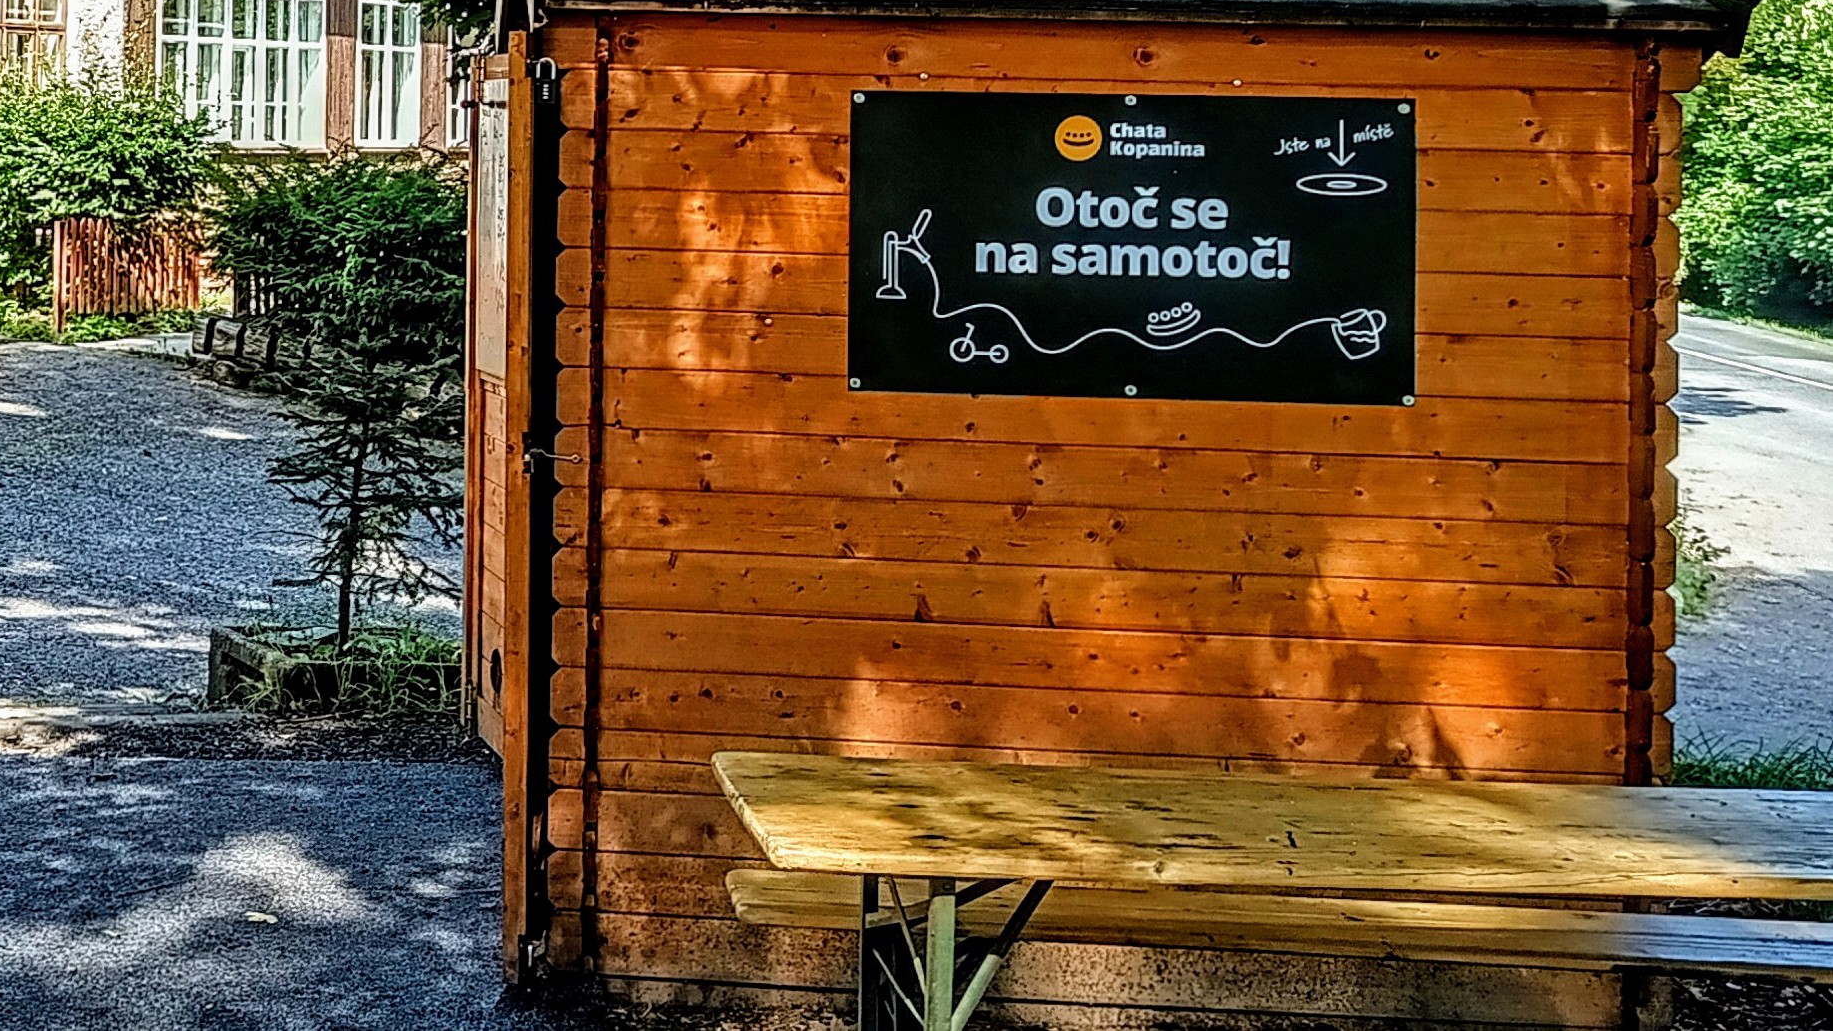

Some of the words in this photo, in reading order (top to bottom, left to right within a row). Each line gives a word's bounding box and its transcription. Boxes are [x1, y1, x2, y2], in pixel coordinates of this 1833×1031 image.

[1109, 121, 1167, 139] Chata
[1273, 136, 1310, 156] Jste
[1314, 136, 1332, 149] na
[1353, 122, 1395, 144] místě
[1109, 140, 1206, 160] Kopanina
[1035, 185, 1160, 229] Otoč
[1170, 195, 1229, 230] se
[974, 240, 1038, 274] na
[1051, 236, 1291, 280] samotoč!
